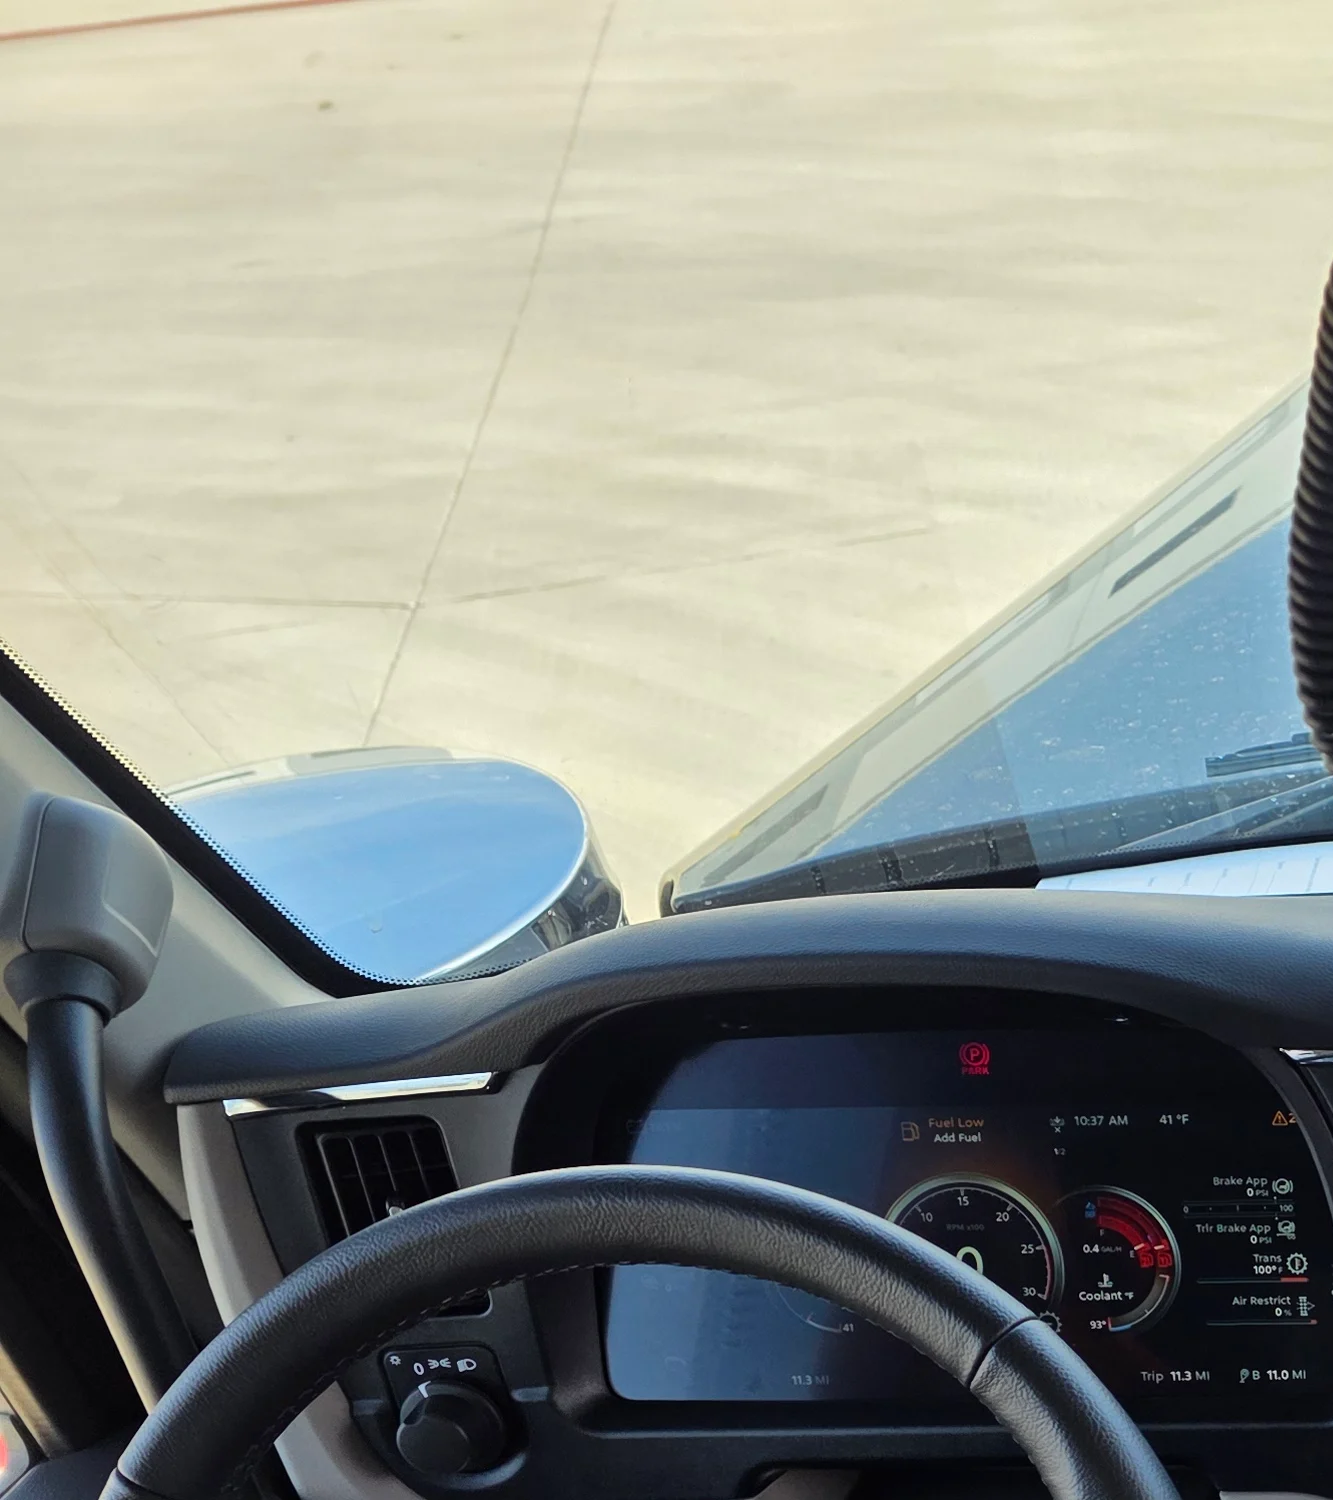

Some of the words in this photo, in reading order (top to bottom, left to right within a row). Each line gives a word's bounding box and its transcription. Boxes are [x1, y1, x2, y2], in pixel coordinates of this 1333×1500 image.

[961, 1066, 989, 1075] PARK
[928, 1118, 954, 1128] Fuel
[958, 1118, 984, 1128] Low
[1074, 1116, 1104, 1126] 10:37
[1109, 1115, 1128, 1125] AM
[1159, 1114, 1173, 1124] 41
[934, 1133, 955, 1143] Add
[958, 1132, 982, 1143] Fuel
[1213, 1177, 1243, 1186] Brake
[1246, 1177, 1268, 1188] App
[1246, 1188, 1254, 1197] 0
[957, 1196, 969, 1206] 15
[1279, 1204, 1293, 1212] 100
[921, 1212, 933, 1223] 10
[996, 1212, 1010, 1222] 20
[1216, 1223, 1247, 1233] Brake
[1249, 1224, 1271, 1235] App
[1250, 1235, 1258, 1244] 0
[1021, 1244, 1035, 1254] 25
[1083, 1244, 1099, 1253] 0.4
[1253, 1254, 1282, 1263] Trans
[1022, 1287, 1036, 1297] 30
[1079, 1291, 1122, 1301] Coolant
[1232, 1297, 1247, 1306] Air
[1251, 1296, 1291, 1305] Restrict
[791, 1375, 812, 1385] 11.3
[1141, 1371, 1164, 1384] Trip
[1170, 1371, 1192, 1381] 11.3
[1195, 1371, 1210, 1381] MI
[1267, 1370, 1289, 1380] 11.0
[1292, 1370, 1306, 1379] MI
